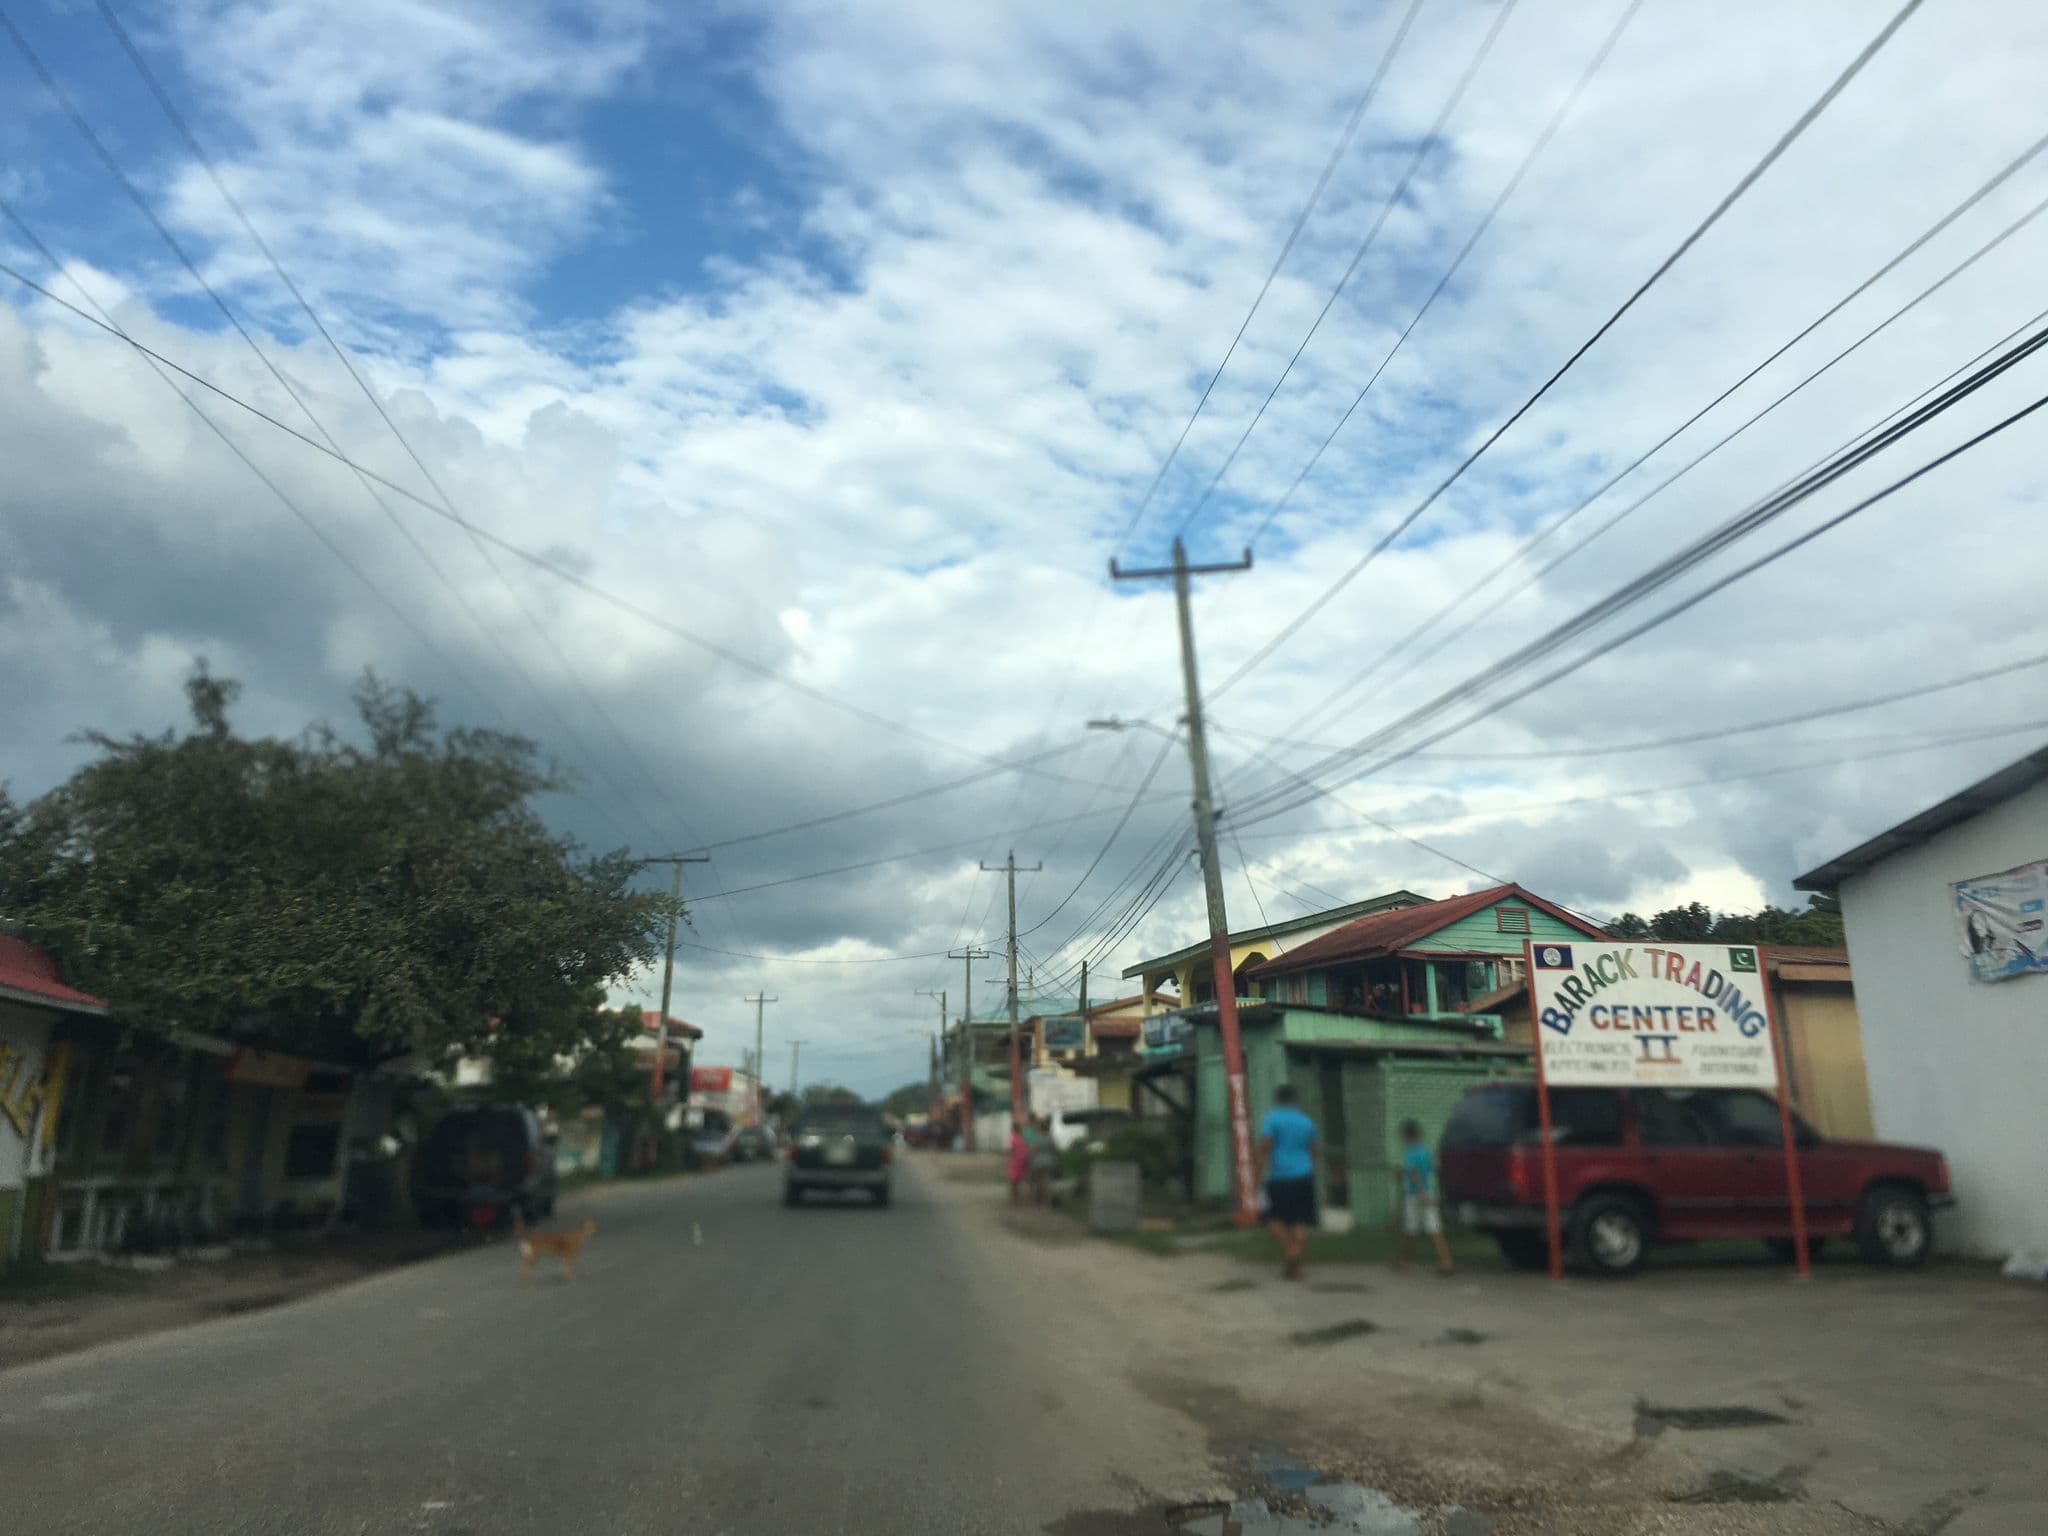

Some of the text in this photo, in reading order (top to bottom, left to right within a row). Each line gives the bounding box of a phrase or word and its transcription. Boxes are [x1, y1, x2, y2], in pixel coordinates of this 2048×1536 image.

[1540, 948, 1766, 1039] BARACK TRADING
[1589, 1004, 1718, 1033] CENTER
